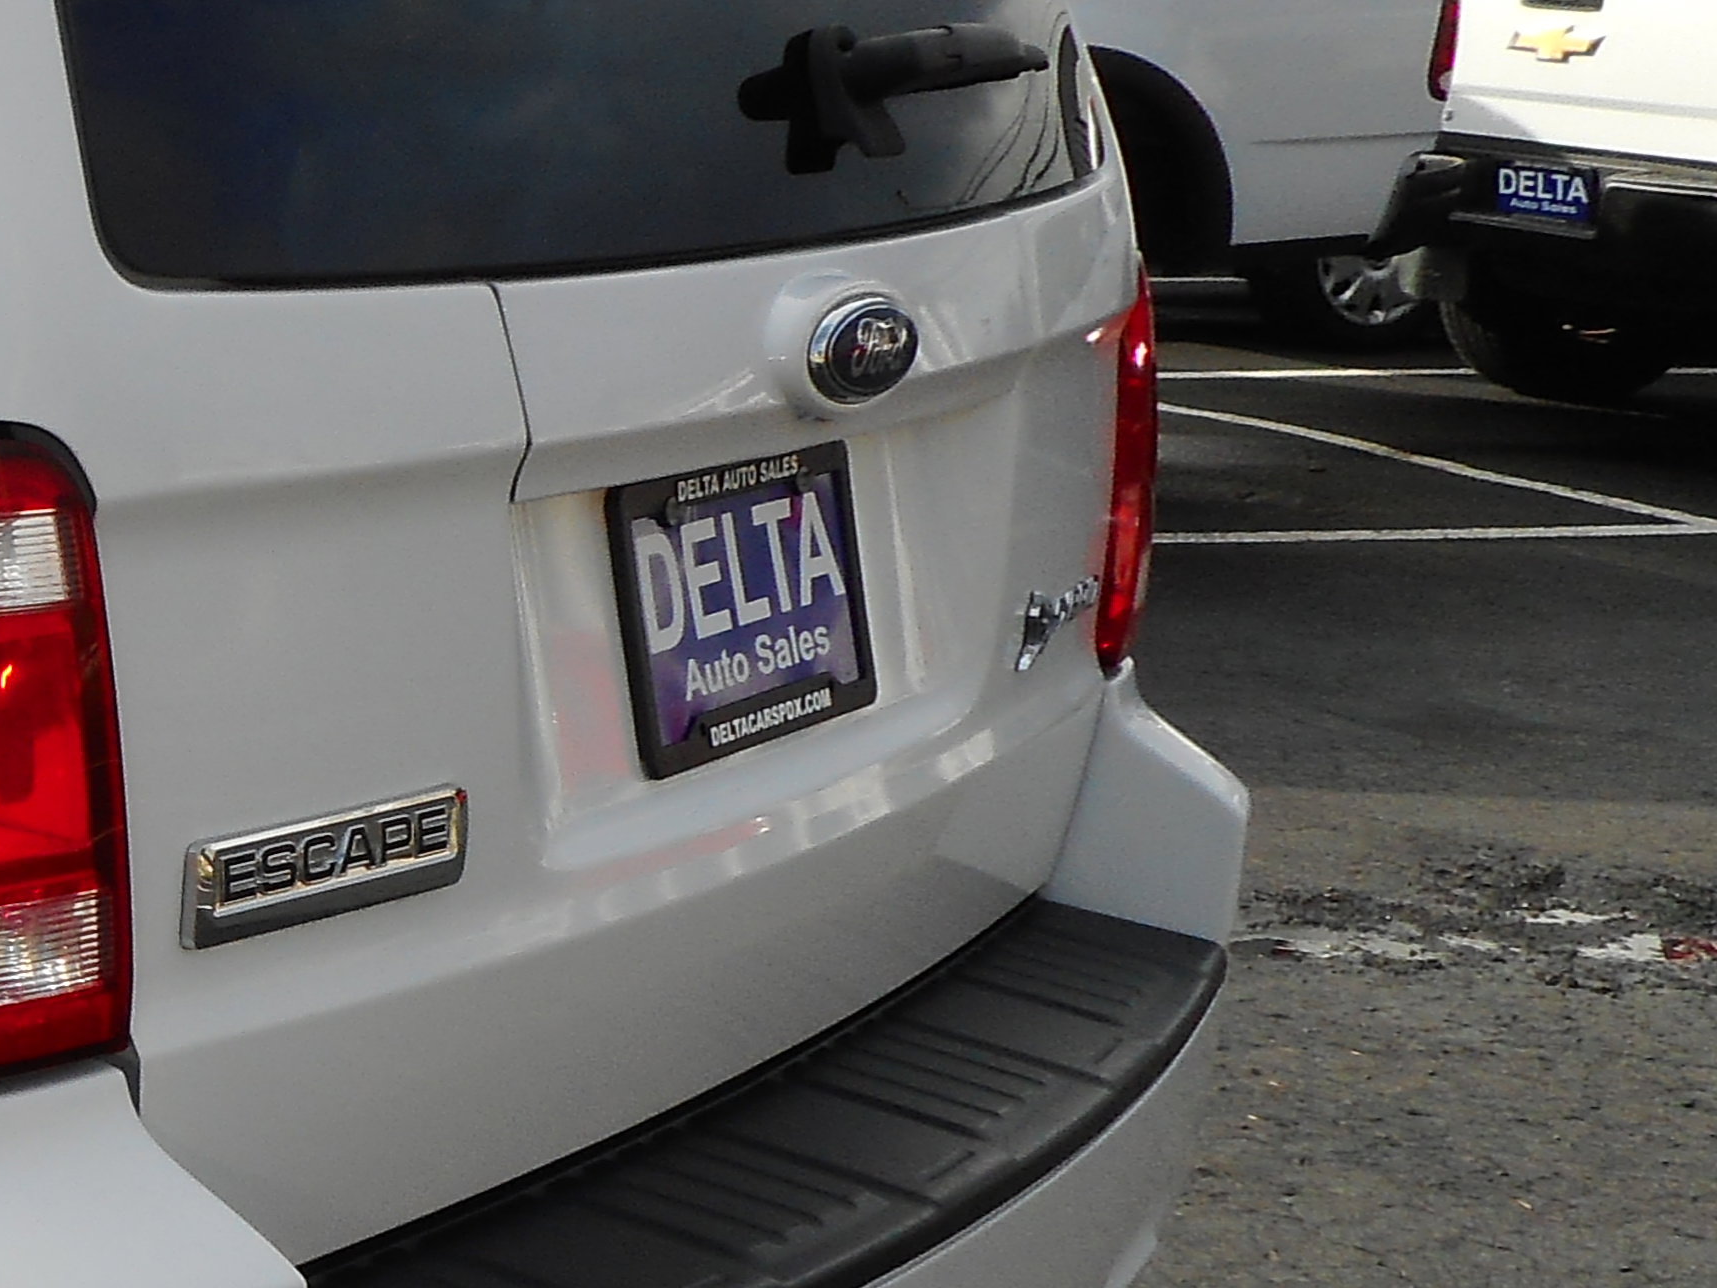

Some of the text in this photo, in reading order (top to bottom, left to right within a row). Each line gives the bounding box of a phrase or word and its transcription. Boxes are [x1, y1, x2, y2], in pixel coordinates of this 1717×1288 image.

[1498, 168, 1589, 204] DELTA
[677, 454, 800, 503] DELTA AUTO SALES
[631, 491, 847, 655] DELTA
[685, 625, 831, 702] Auto Sales
[709, 687, 833, 748] DELTACARSPDX.COM
[218, 803, 450, 905] ESCAPE
